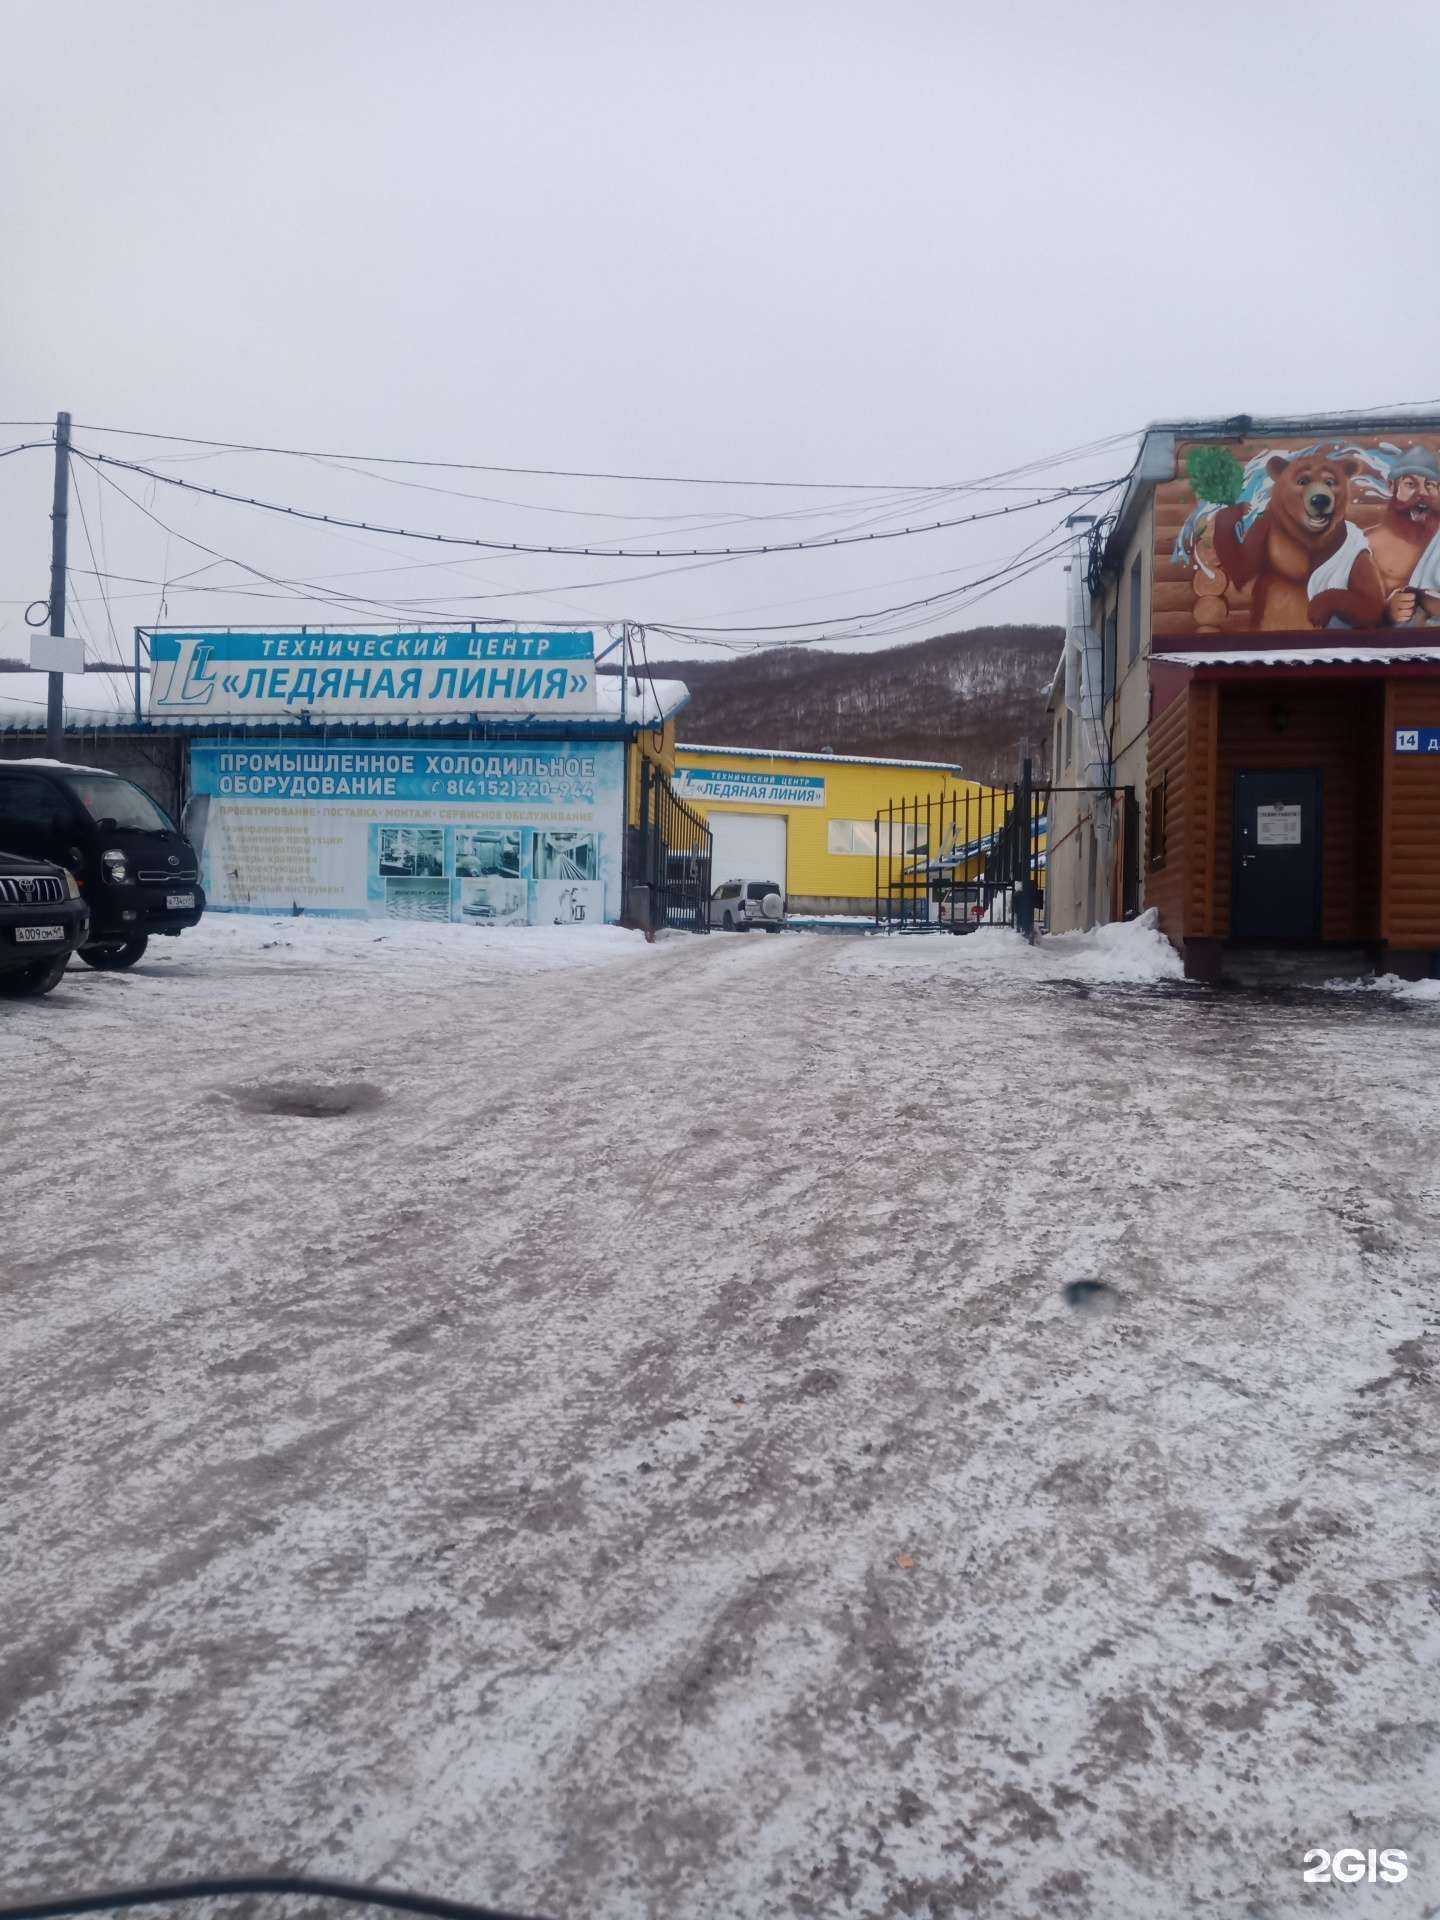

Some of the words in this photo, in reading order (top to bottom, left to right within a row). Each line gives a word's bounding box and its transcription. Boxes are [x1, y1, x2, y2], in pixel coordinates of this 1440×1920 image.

[262, 636, 448, 657] ТЕХНИЧЕСКИЙ
[468, 638, 550, 659] ЦЕНТР
[222, 667, 423, 705] «ЛЕДЯНАЯ
[428, 667, 588, 700] ЛИНИЯ»
[1398, 734, 1416, 747] 14
[219, 753, 415, 774] ПРОМЫШЛЕННОЕ
[425, 755, 595, 778] ХОЛОДИЛЬНОЕ
[219, 775, 397, 797] ОБОРУДОВАНИЕ
[447, 780, 593, 798] 8(4152)220-944
[711, 771, 776, 784] ТЕХНИЧЕСКИЙ
[781, 777, 810, 786] ЦЕНТР
[696, 782, 767, 799] «ЛЕДЯНАЯ
[768, 788, 821, 802] ЛИНИЯ»
